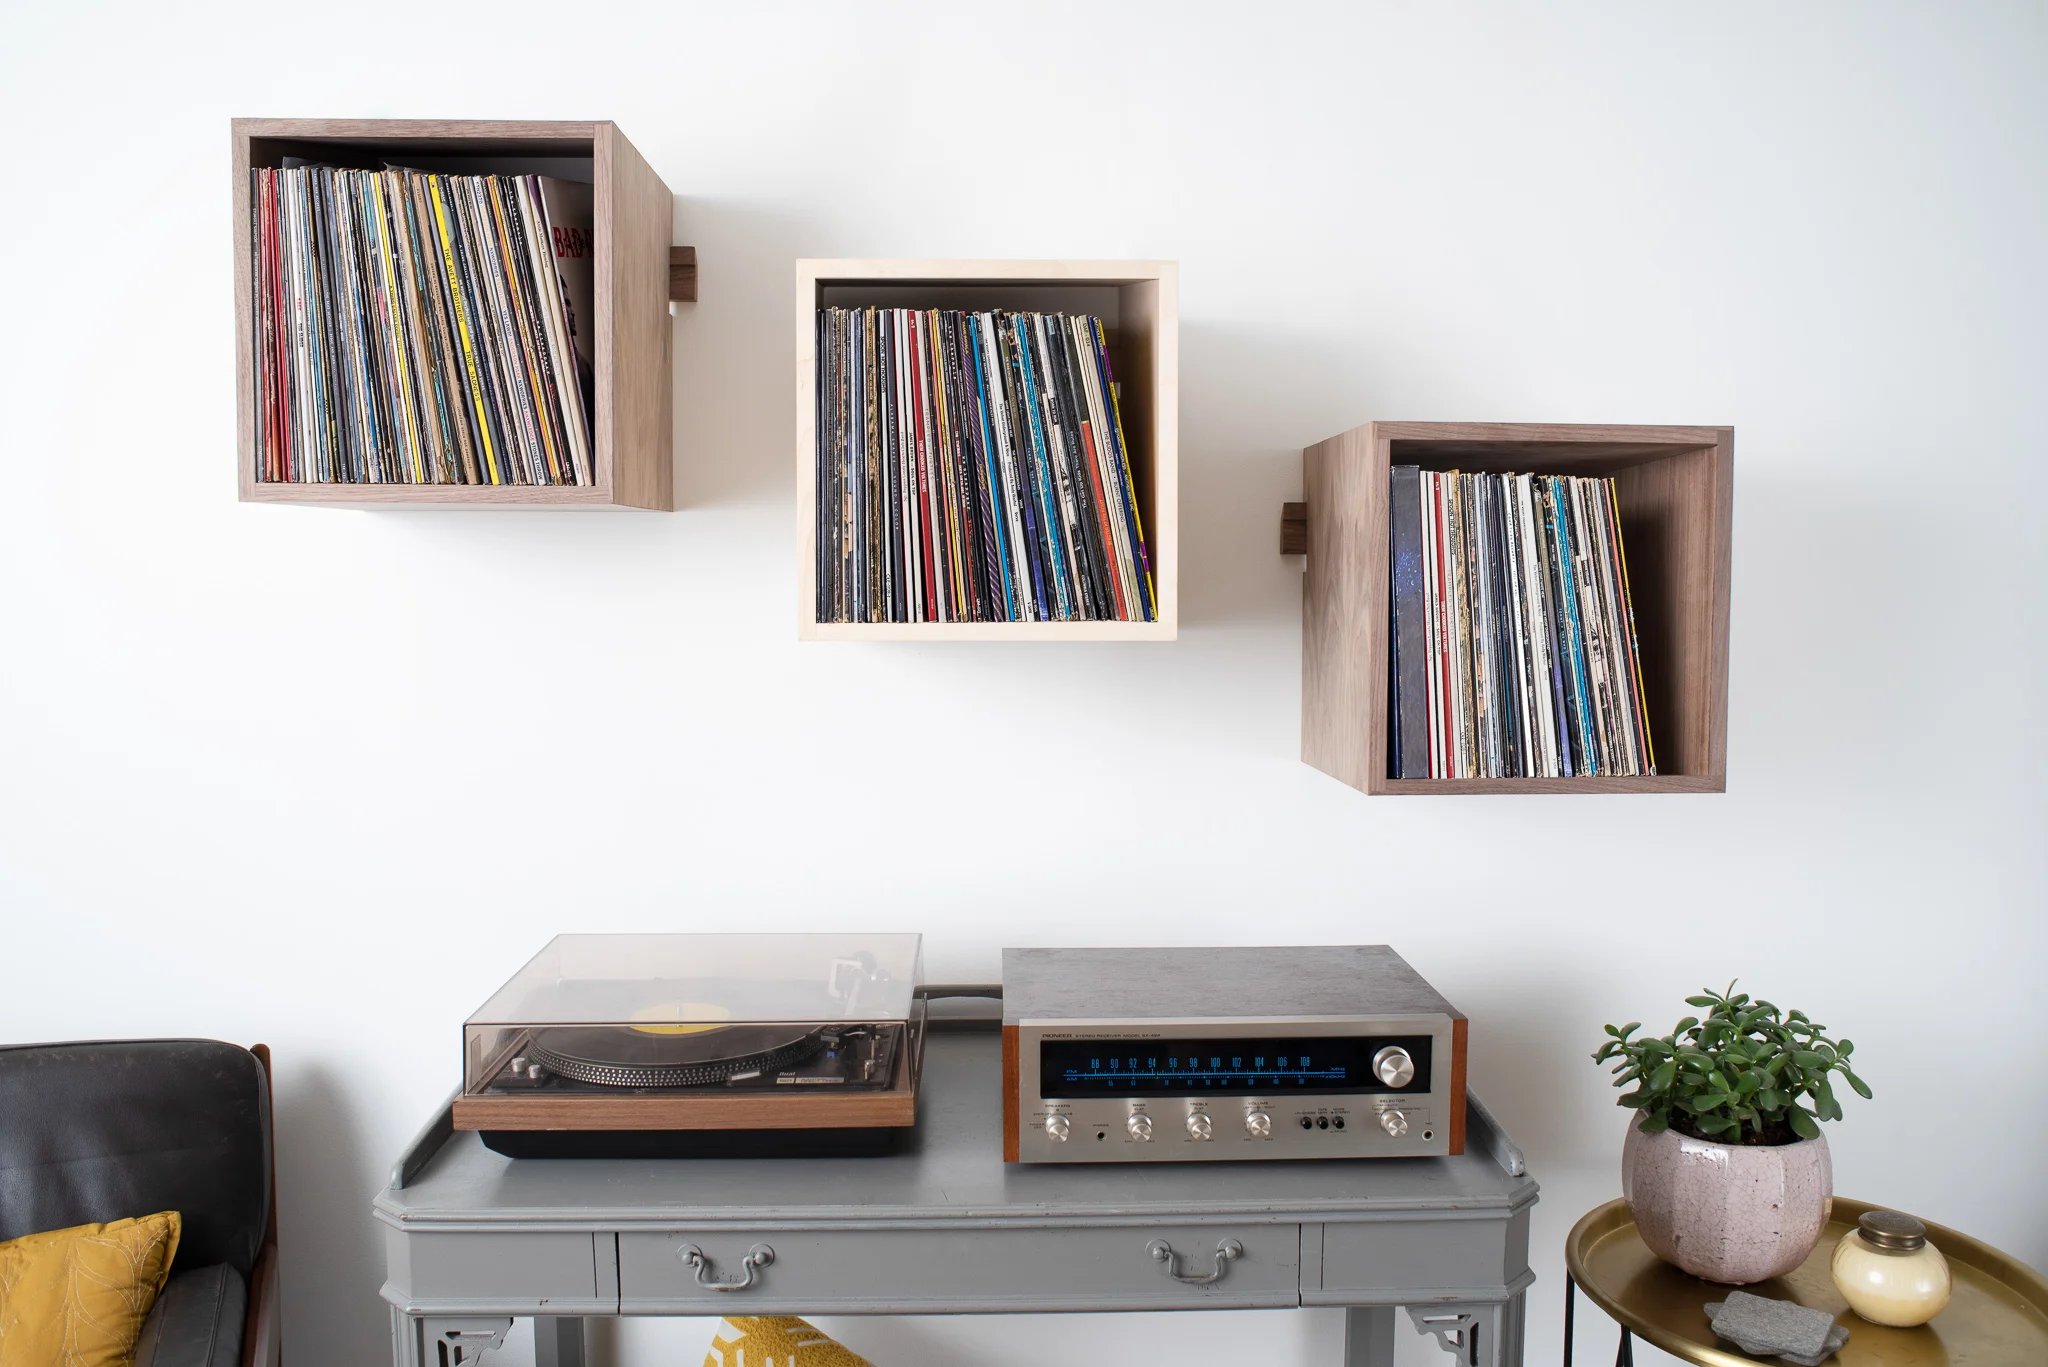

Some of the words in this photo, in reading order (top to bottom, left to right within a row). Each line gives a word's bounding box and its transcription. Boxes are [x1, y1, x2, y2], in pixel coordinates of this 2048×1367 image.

[552, 226, 583, 259] BAD
[443, 247, 451, 261] THE
[446, 263, 456, 285] AVETT
[451, 286, 464, 323] BROTHERS
[464, 349, 473, 368] TRUE
[468, 370, 480, 402] SADNESS
[517, 378, 528, 410] NXWORRIES
[1000, 421, 1008, 443] Underground
[530, 441, 539, 461] STONES
[1104, 439, 1113, 458] BUDOS
[534, 461, 543, 480] THROW
[1108, 458, 1116, 474] BAND
[1077, 481, 1084, 489] Up
[1112, 480, 1120, 497] BURNT
[1115, 498, 1125, 523] OFFERING
[1091, 1058, 1100, 1069] 88
[1110, 1058, 1119, 1069] 90
[1128, 1058, 1137, 1069] 92
[1148, 1057, 1156, 1068] 94
[1169, 1057, 1178, 1068] 96
[1189, 1057, 1198, 1068] 98
[1210, 1057, 1221, 1068] 100
[1232, 1057, 1242, 1068] 102
[1255, 1056, 1264, 1068] 104
[1277, 1056, 1288, 1067] 106
[1300, 1056, 1310, 1067] 108
